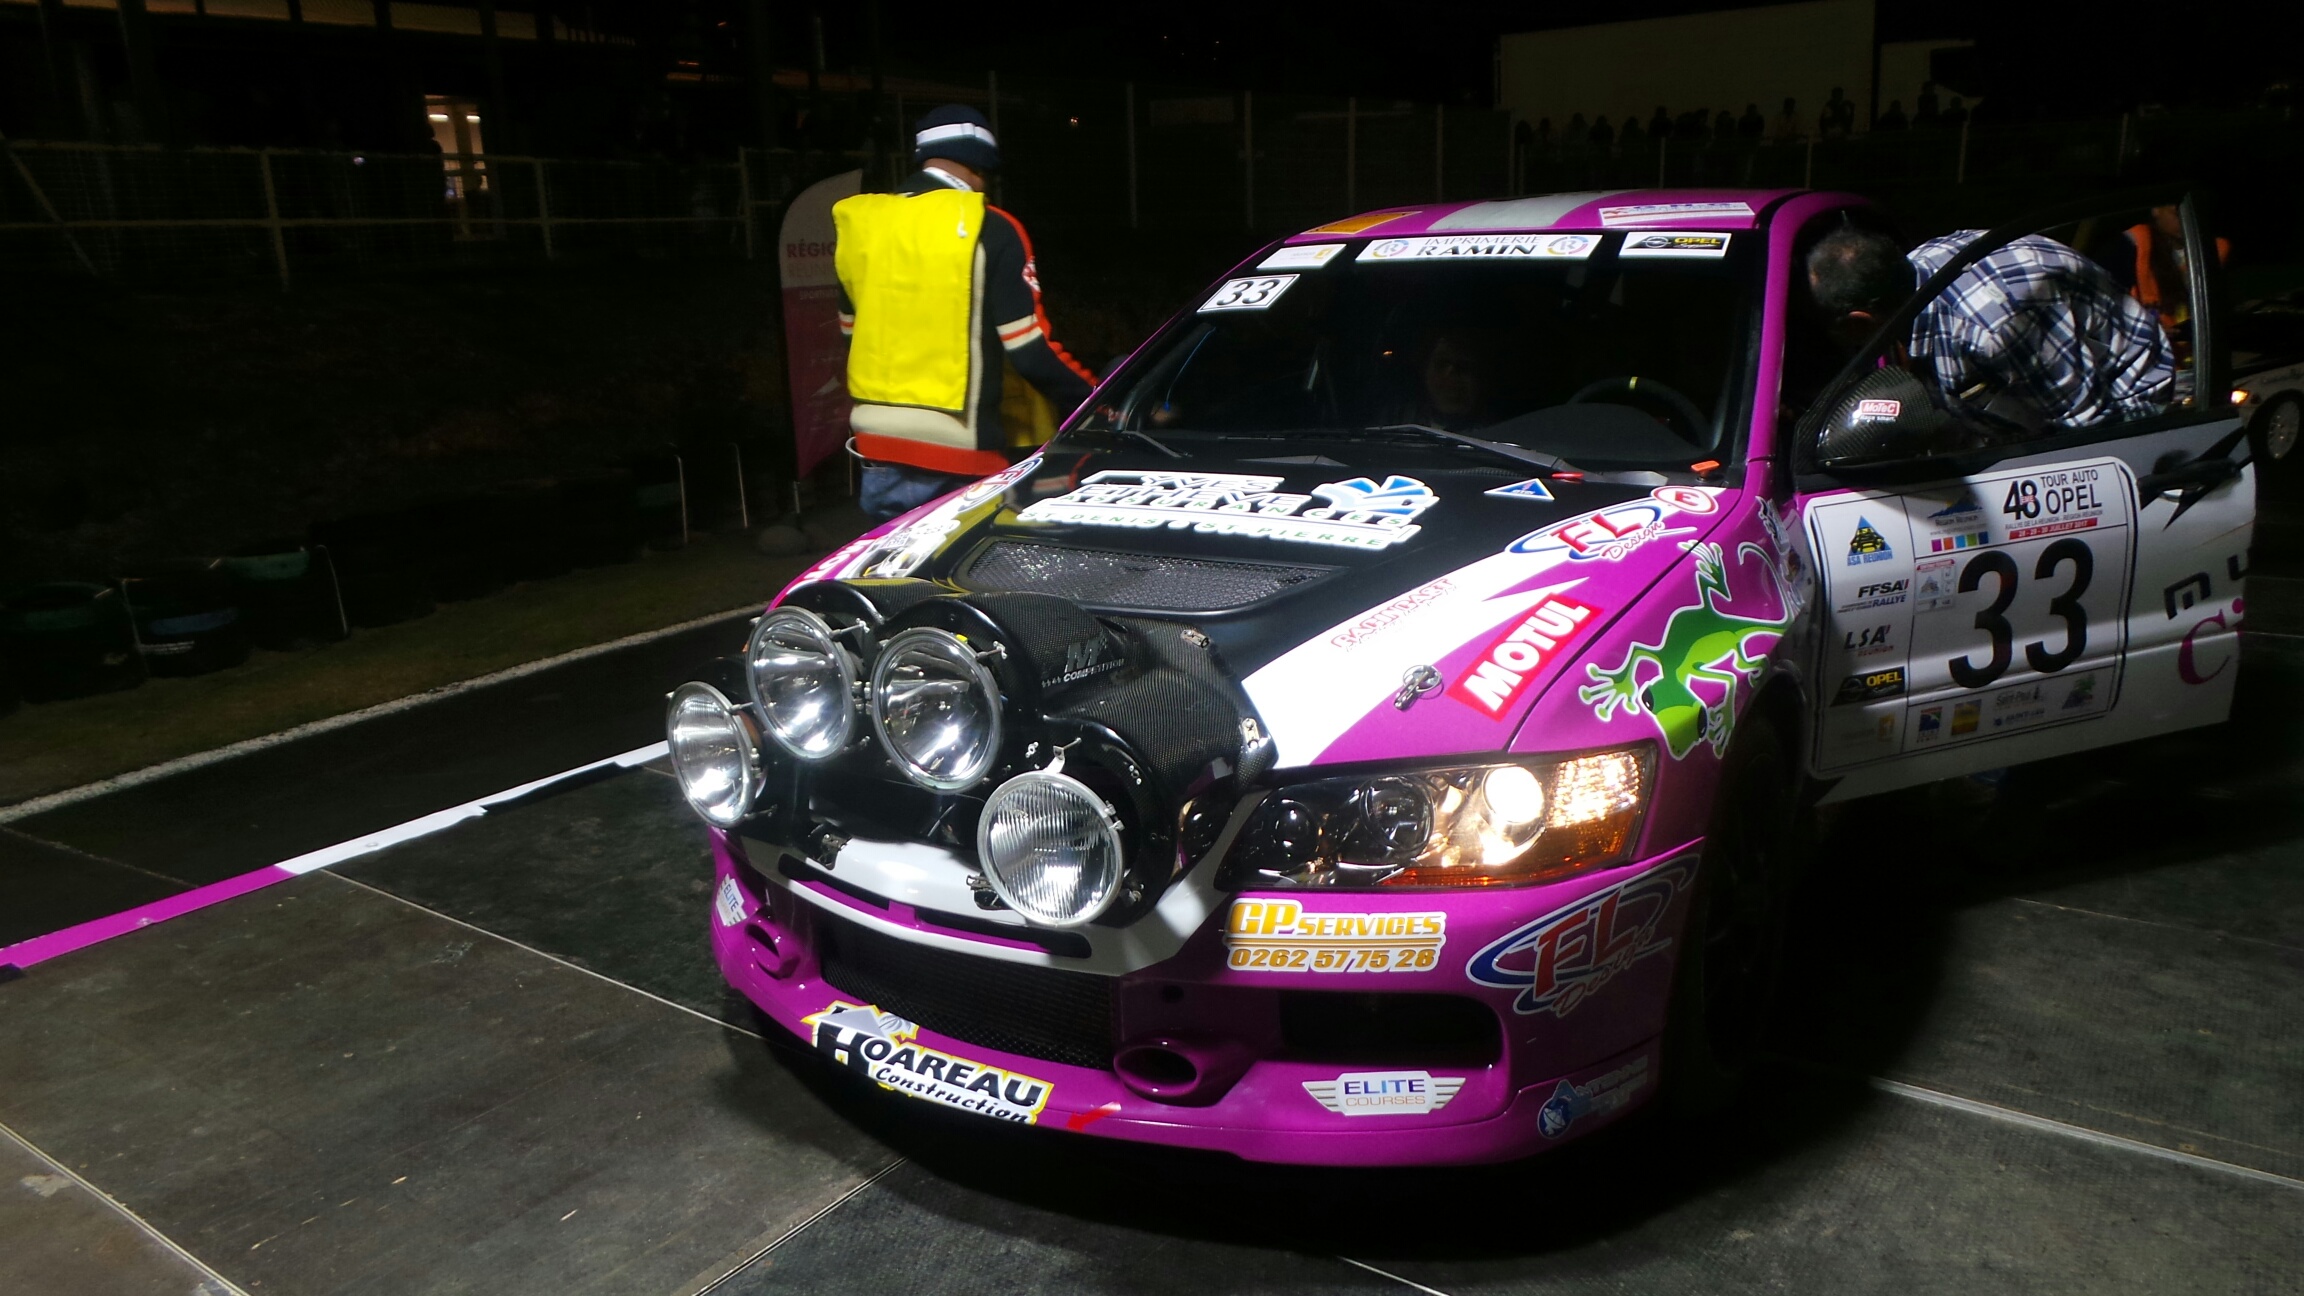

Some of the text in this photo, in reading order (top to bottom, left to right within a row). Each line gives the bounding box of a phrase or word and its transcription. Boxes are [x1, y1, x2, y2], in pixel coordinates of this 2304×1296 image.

[1416, 244, 1538, 257] RAMIN
[1424, 235, 1543, 246] IMPRIMERIE
[1674, 237, 1721, 245] OPEL
[1216, 278, 1281, 306] 33
[1862, 402, 1896, 413] MoTeC
[1141, 474, 1281, 492] YVES
[2040, 468, 2099, 489] TOUR AUTO
[1060, 494, 1403, 526] ASSURANCES
[2003, 479, 2103, 520] 48 OPEL
[1069, 513, 1158, 525] DENIS
[1601, 521, 1662, 559] Design
[1858, 579, 1906, 598] FFSA
[1872, 594, 1907, 608] RALLYE
[1948, 537, 2094, 689] 33
[1843, 624, 1887, 650] LSA
[1463, 599, 1591, 712] MOTUL
[1063, 658, 1125, 683] COMPETITION
[1865, 671, 1903, 689] OPEL
[723, 884, 740, 913] ELITE
[1229, 902, 1442, 936] GP SERVICES
[1231, 949, 1436, 968] 0262 57 75 28
[815, 1018, 1044, 1107] HOAREAU
[876, 1066, 1030, 1124] Construction
[1344, 1078, 1426, 1095] ELITE
[1345, 1095, 1426, 1107] COURSES
